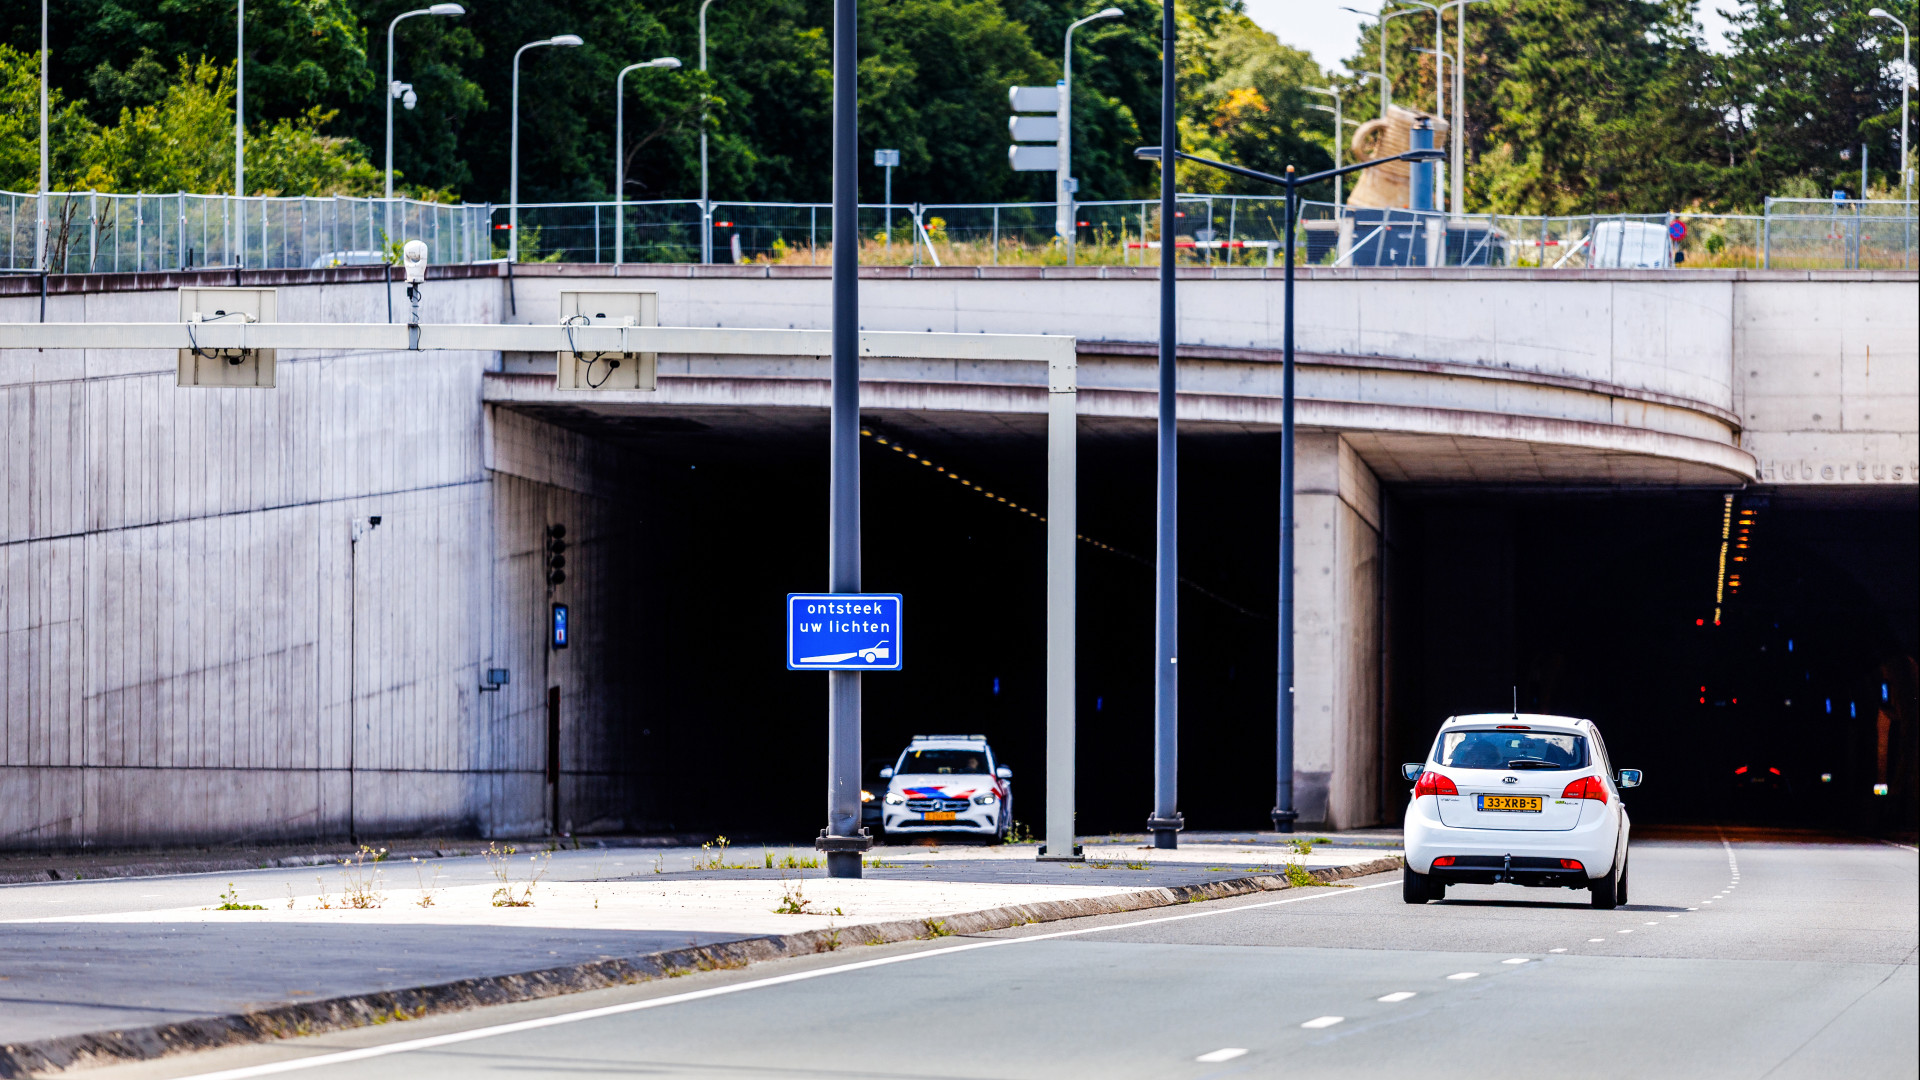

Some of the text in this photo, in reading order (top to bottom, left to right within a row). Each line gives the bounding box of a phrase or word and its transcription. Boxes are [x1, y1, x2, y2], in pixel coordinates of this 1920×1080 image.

[807, 601, 882, 615] ontsteek
[800, 620, 890, 633] uw lichten
[1487, 797, 1537, 809] 33-XRB-5
